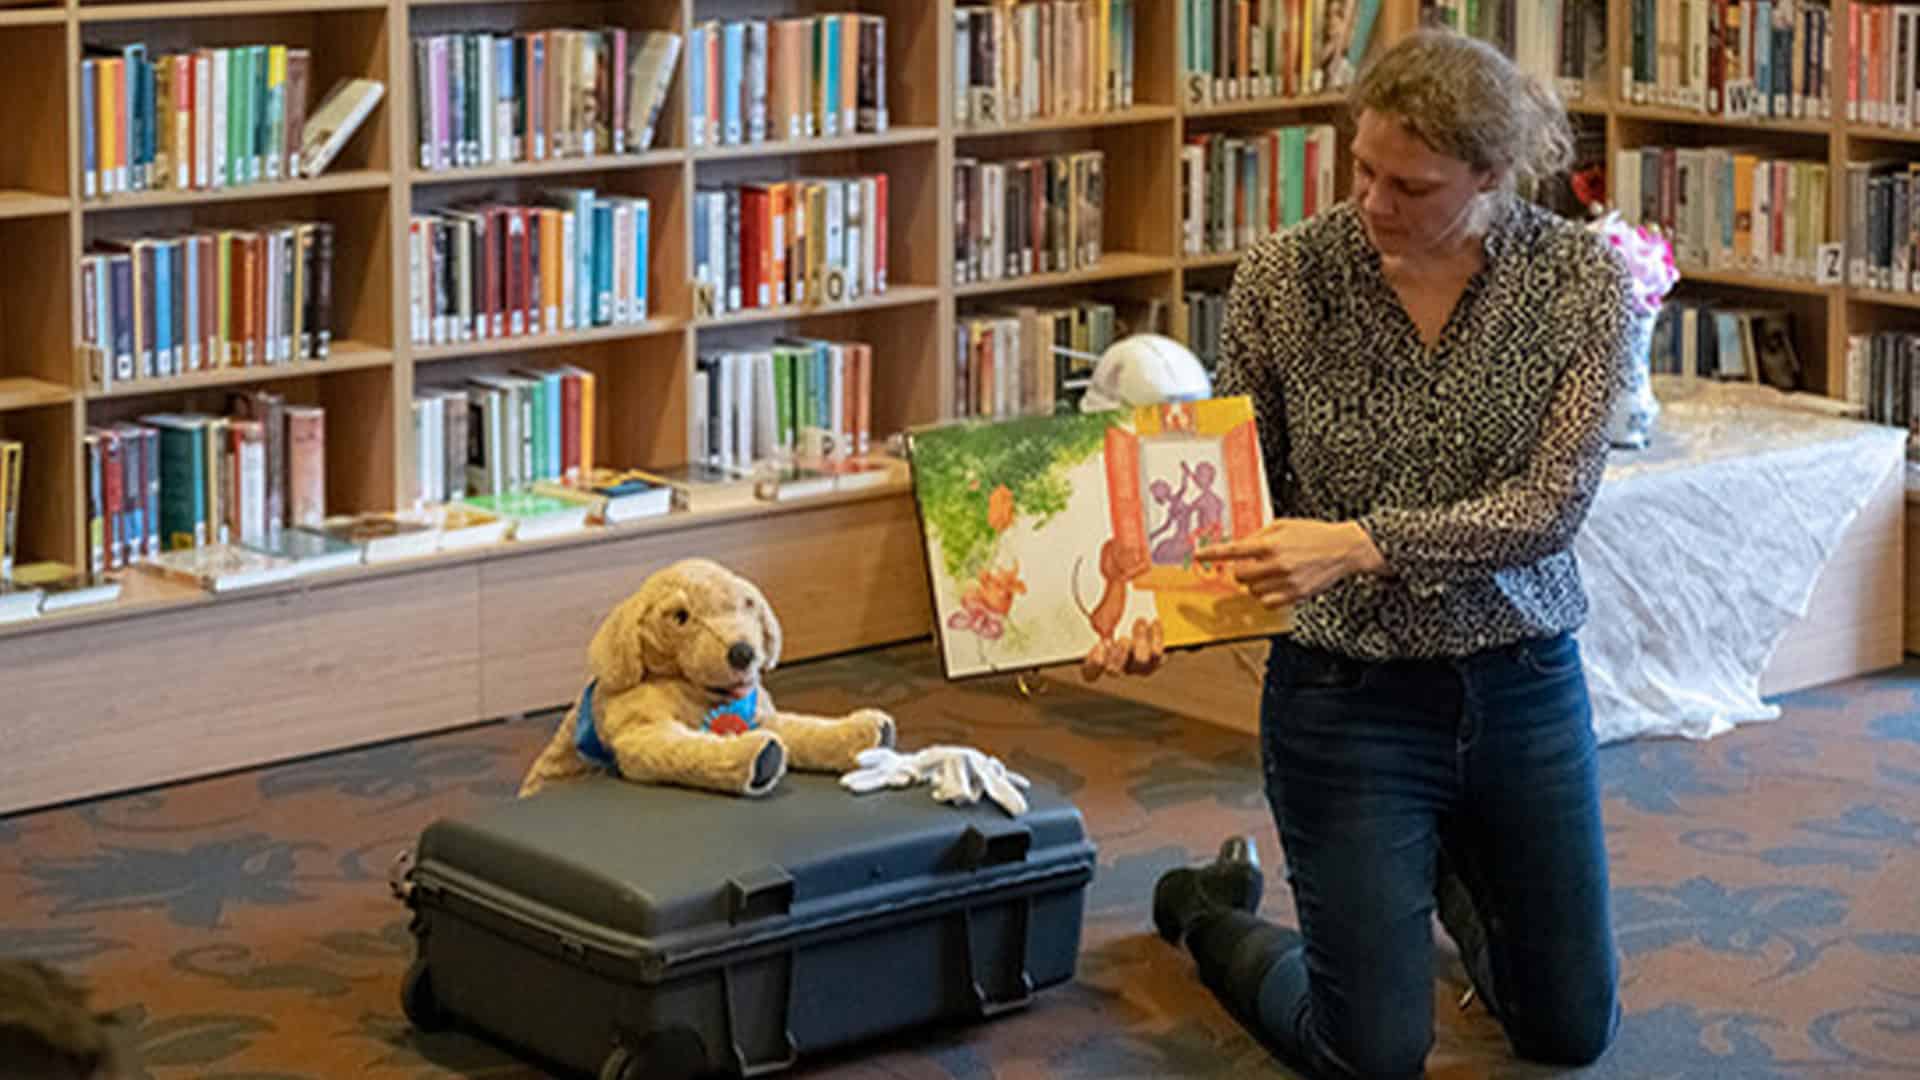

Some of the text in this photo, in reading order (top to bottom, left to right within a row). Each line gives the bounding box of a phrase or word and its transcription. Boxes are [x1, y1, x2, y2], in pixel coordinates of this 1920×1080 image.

[1188, 75, 1204, 105] S
[1727, 85, 1752, 113] W
[1826, 249, 1841, 277] Z
[826, 271, 844, 302] O
